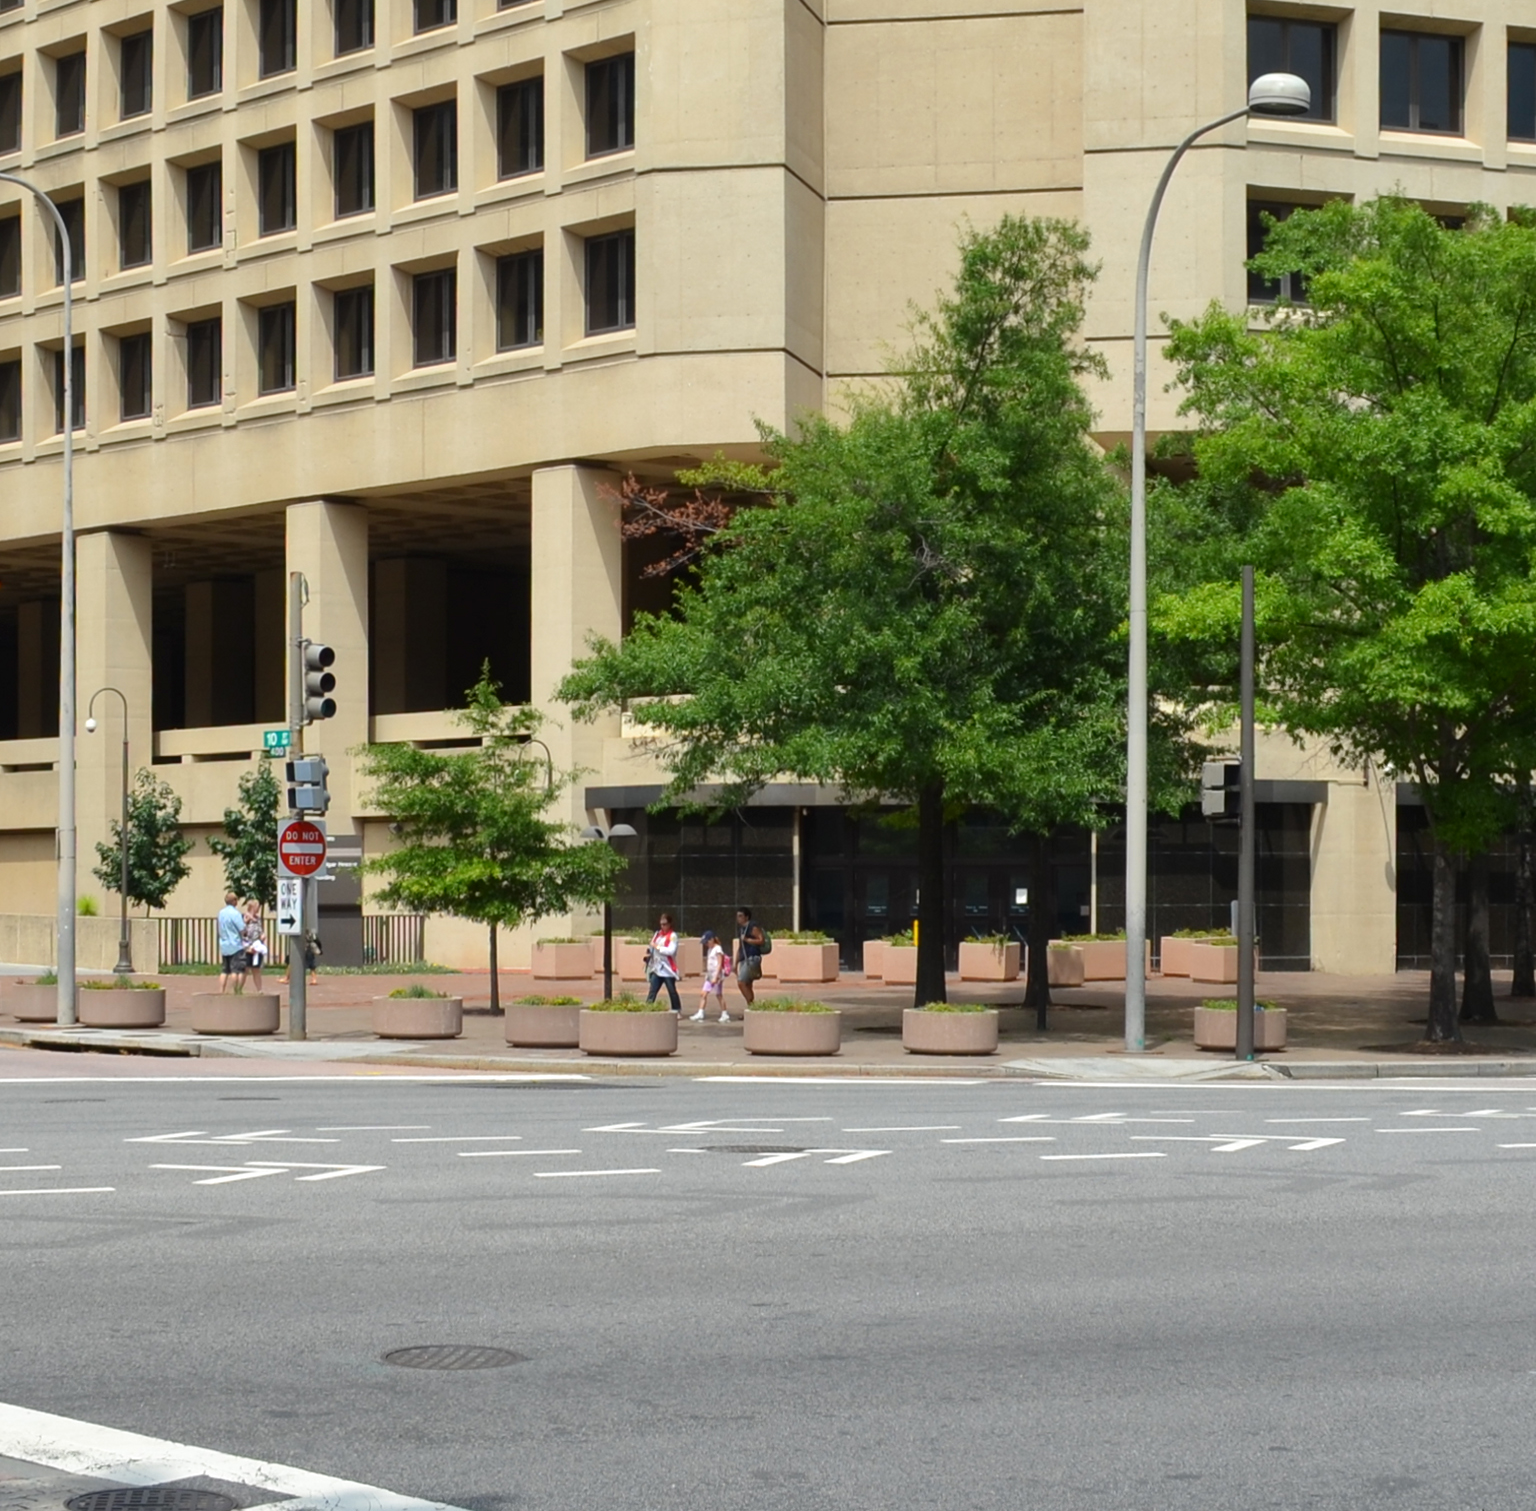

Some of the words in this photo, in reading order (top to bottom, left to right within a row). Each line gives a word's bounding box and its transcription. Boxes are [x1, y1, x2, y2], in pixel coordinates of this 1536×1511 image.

[267, 732, 278, 746] 10
[285, 831, 298, 840] DO
[302, 831, 319, 841] NOT
[289, 855, 316, 865] ENTER
[281, 883, 297, 896] ONE
[281, 898, 297, 910] WAY
